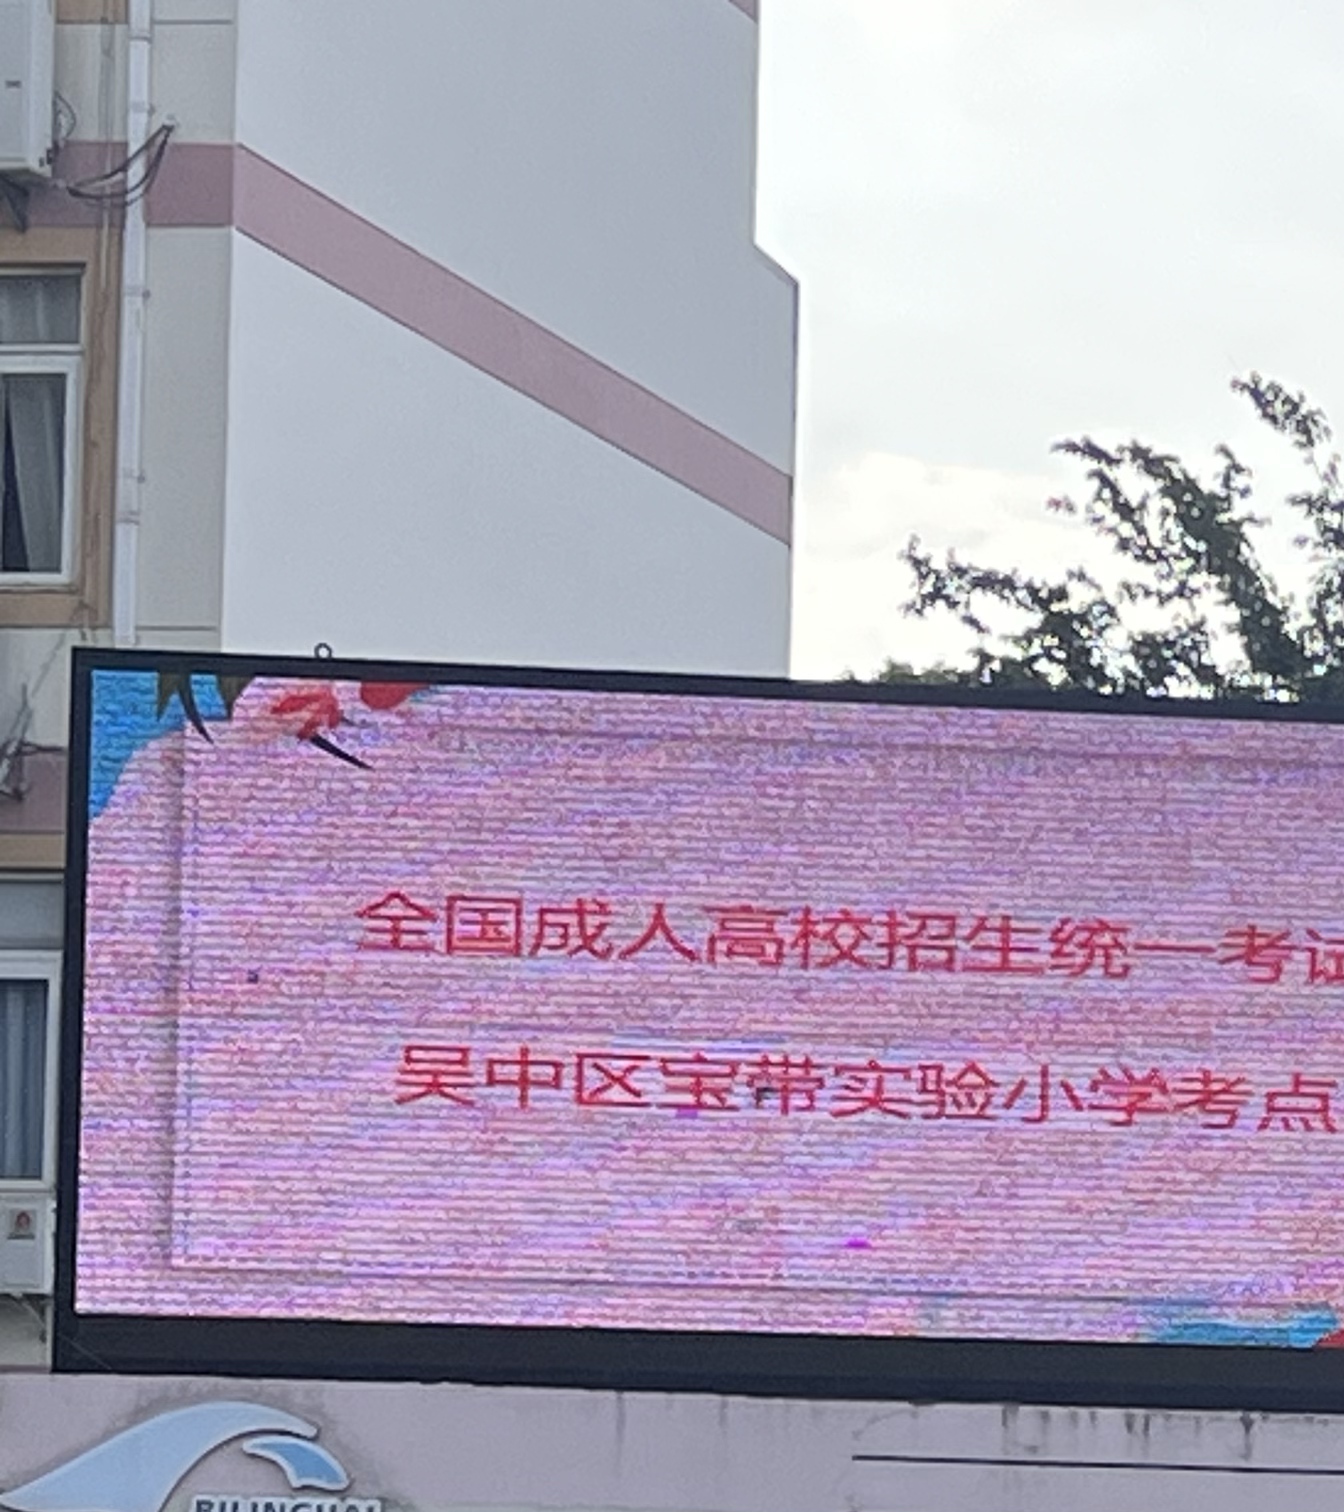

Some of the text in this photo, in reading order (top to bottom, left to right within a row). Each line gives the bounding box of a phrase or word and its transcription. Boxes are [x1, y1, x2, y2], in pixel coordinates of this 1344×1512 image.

[395, 1046, 1337, 1133] 吴中区宝带实验小学考点
